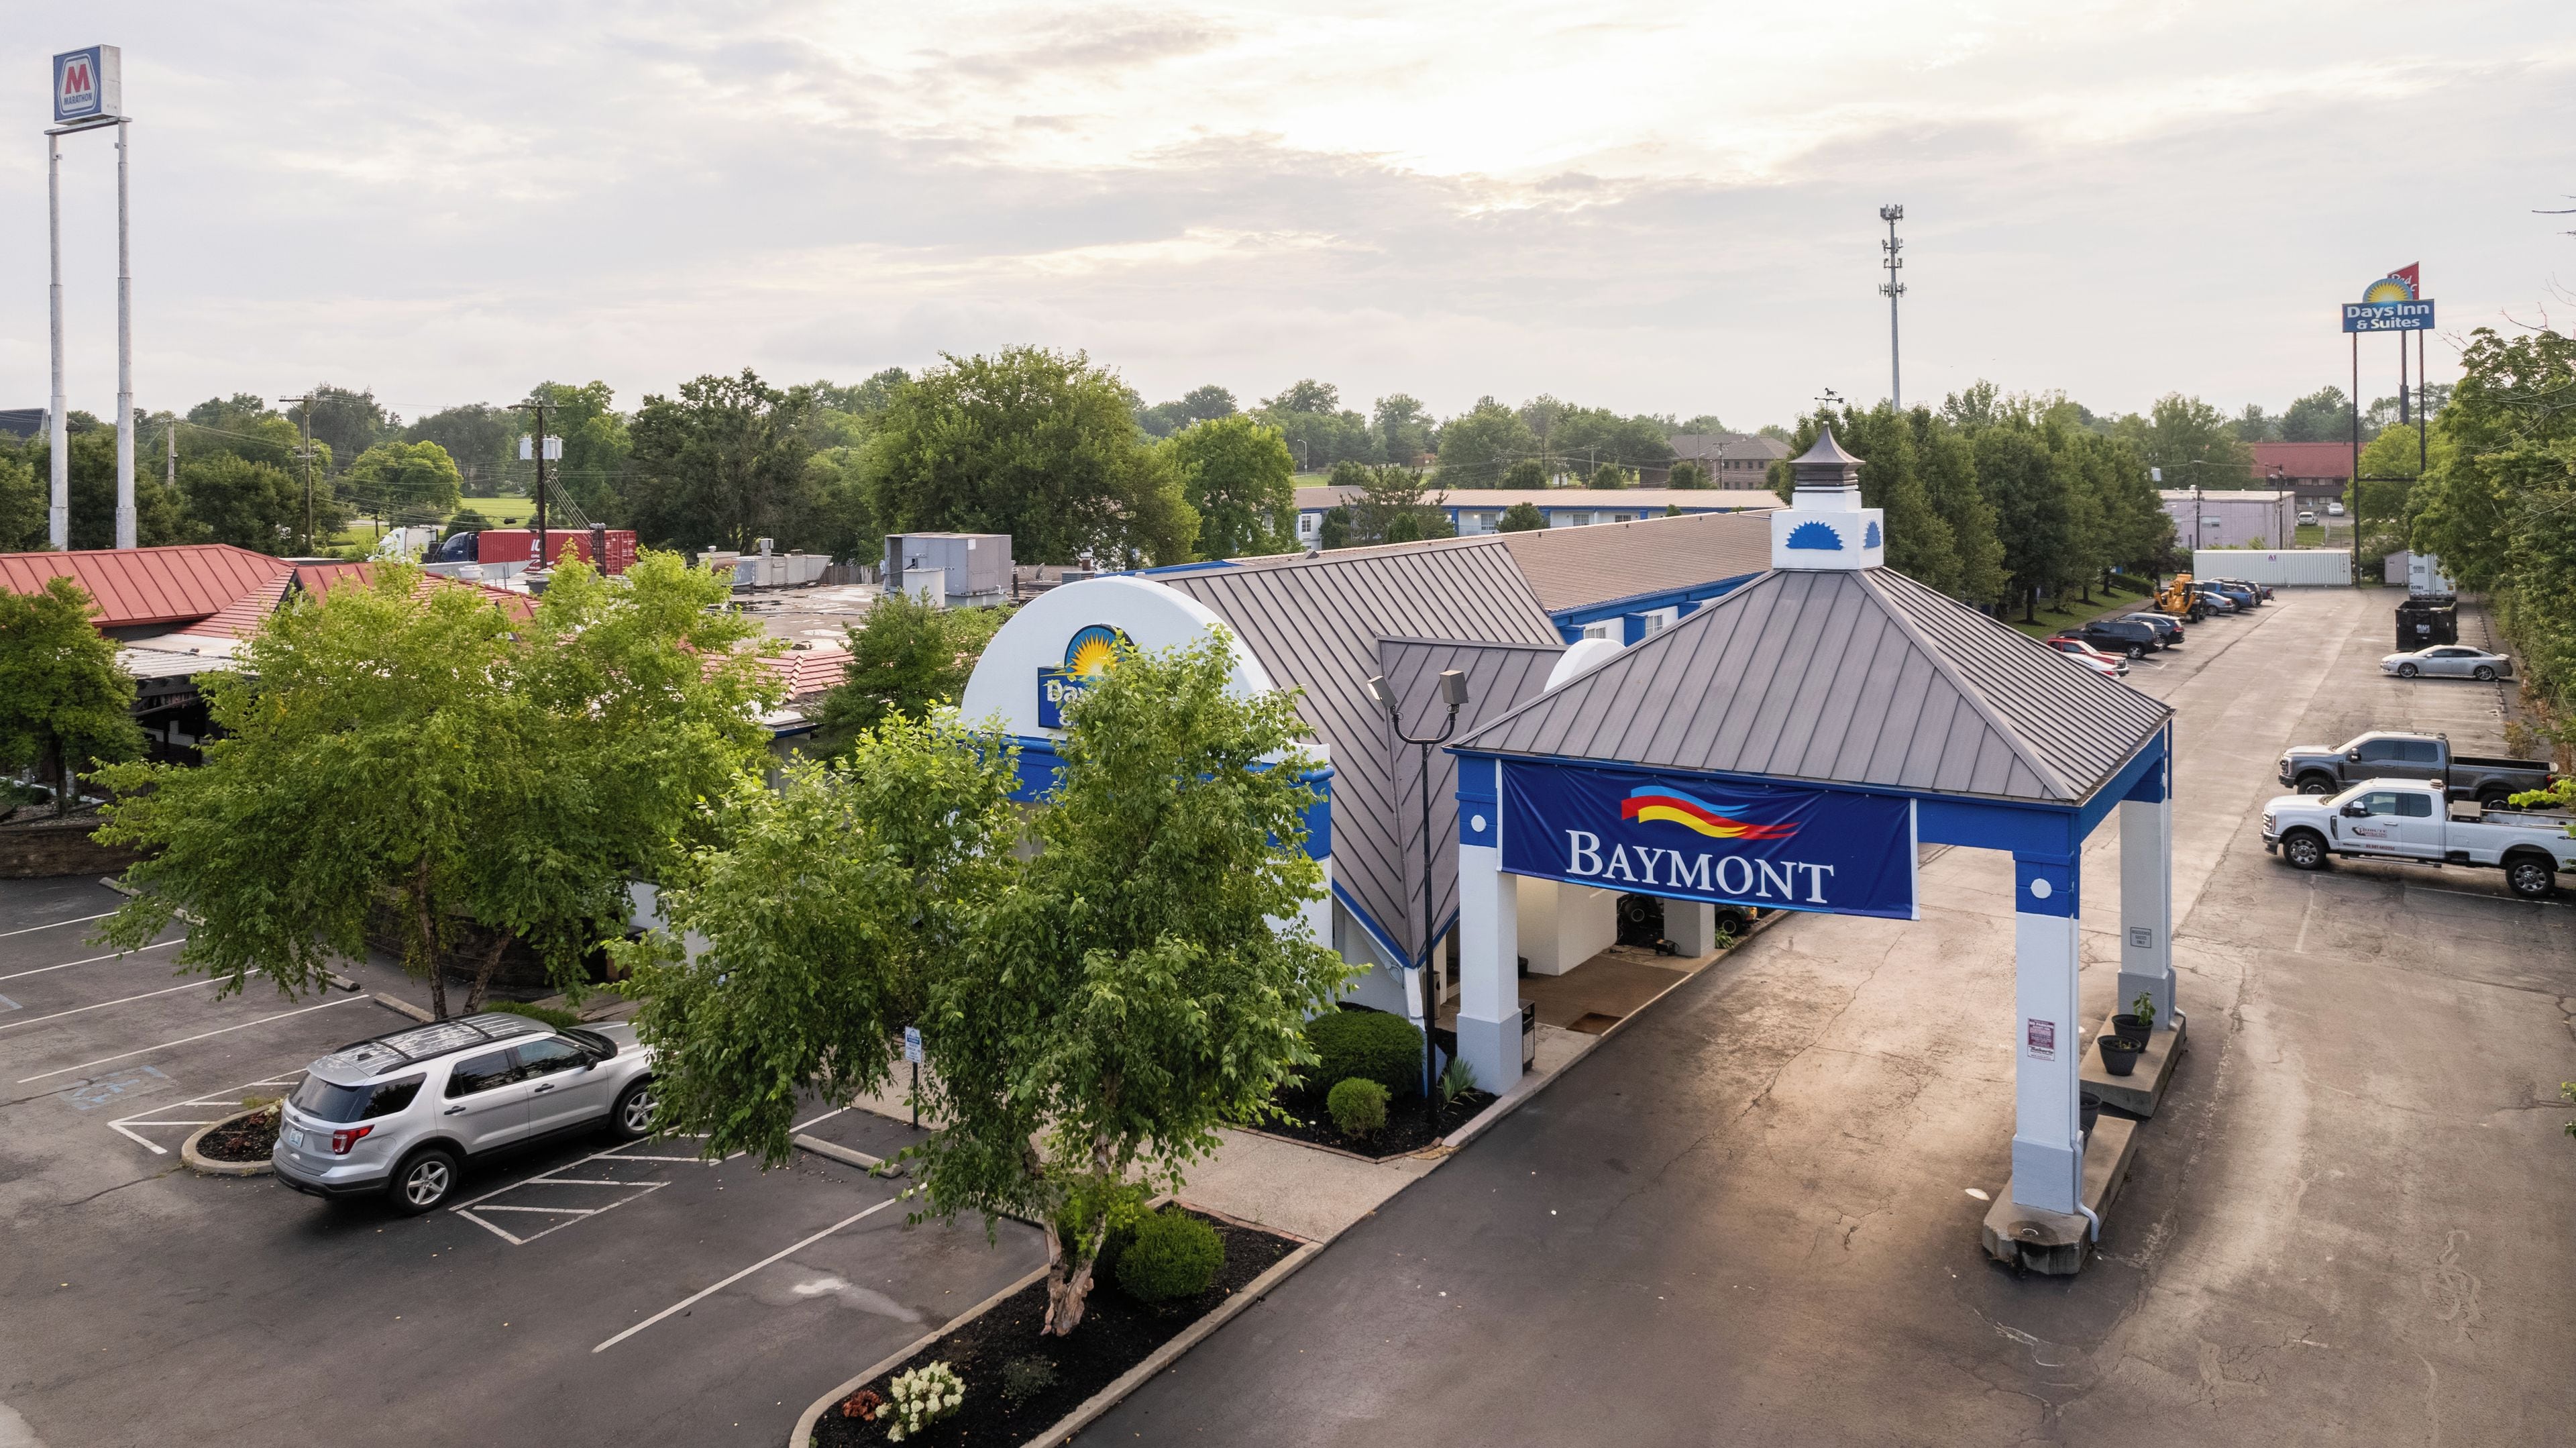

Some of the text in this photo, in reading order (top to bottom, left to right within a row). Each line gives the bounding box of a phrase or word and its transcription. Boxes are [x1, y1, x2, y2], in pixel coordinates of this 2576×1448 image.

[65, 64, 91, 95] M
[64, 93, 93, 105] MARATHON
[2347, 304, 2429, 318] Days Inn
[2357, 317, 2420, 329] & Suites
[1566, 829, 1834, 904] BAYMONT
